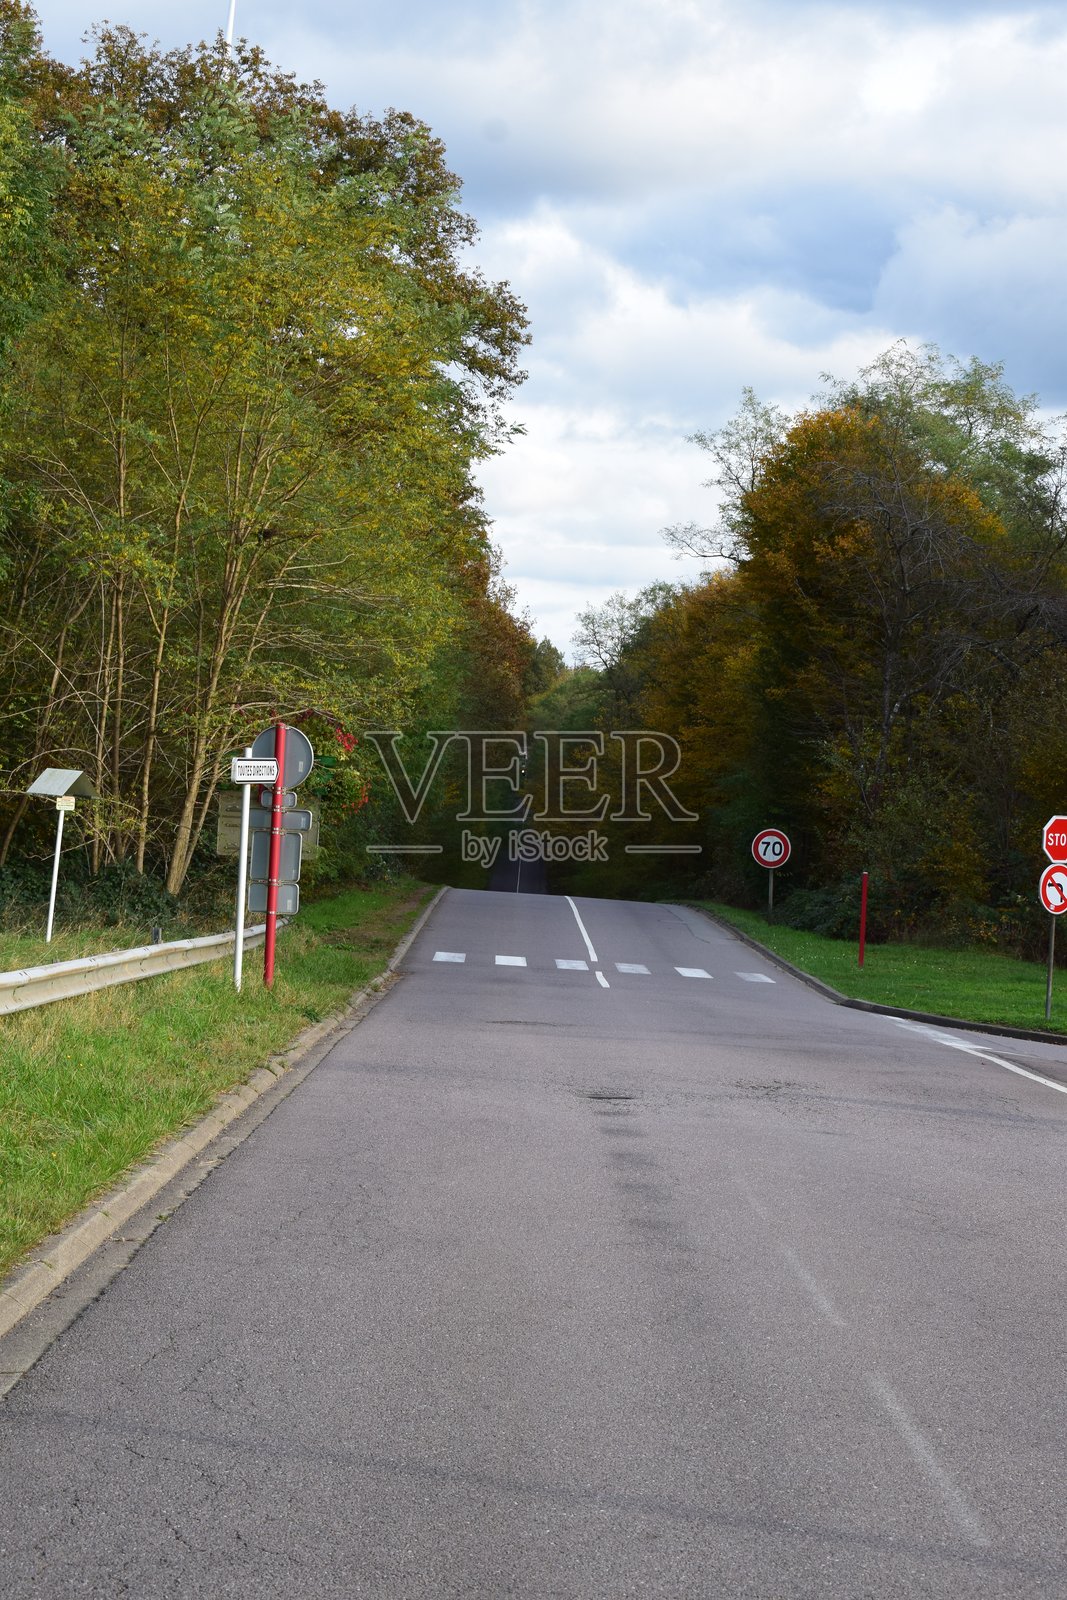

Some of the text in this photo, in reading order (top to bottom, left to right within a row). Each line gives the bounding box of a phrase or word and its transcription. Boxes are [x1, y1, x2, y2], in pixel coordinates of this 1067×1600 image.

[238, 765, 274, 776] TOUTES DIRECTIONS
[1047, 833, 1067, 846] STO
[761, 841, 783, 857] 70
